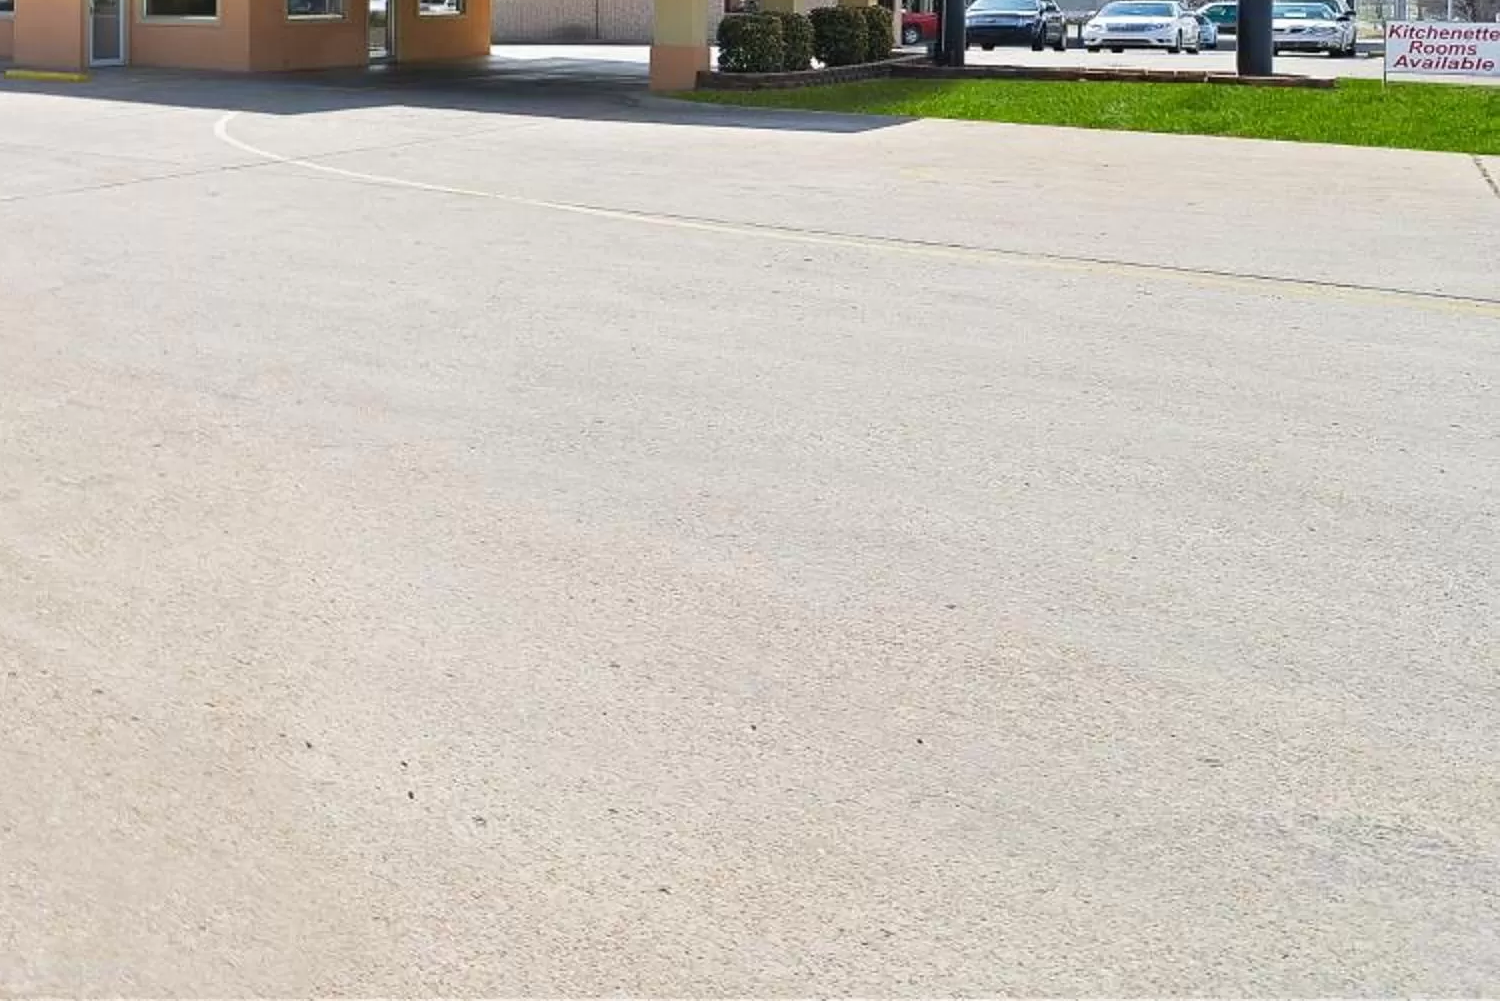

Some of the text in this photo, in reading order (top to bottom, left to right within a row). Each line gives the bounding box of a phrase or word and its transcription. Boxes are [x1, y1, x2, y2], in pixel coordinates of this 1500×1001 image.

[1388, 24, 1500, 41] Kitchenette
[1408, 40, 1477, 55] Rooms
[1393, 54, 1495, 71] Available
